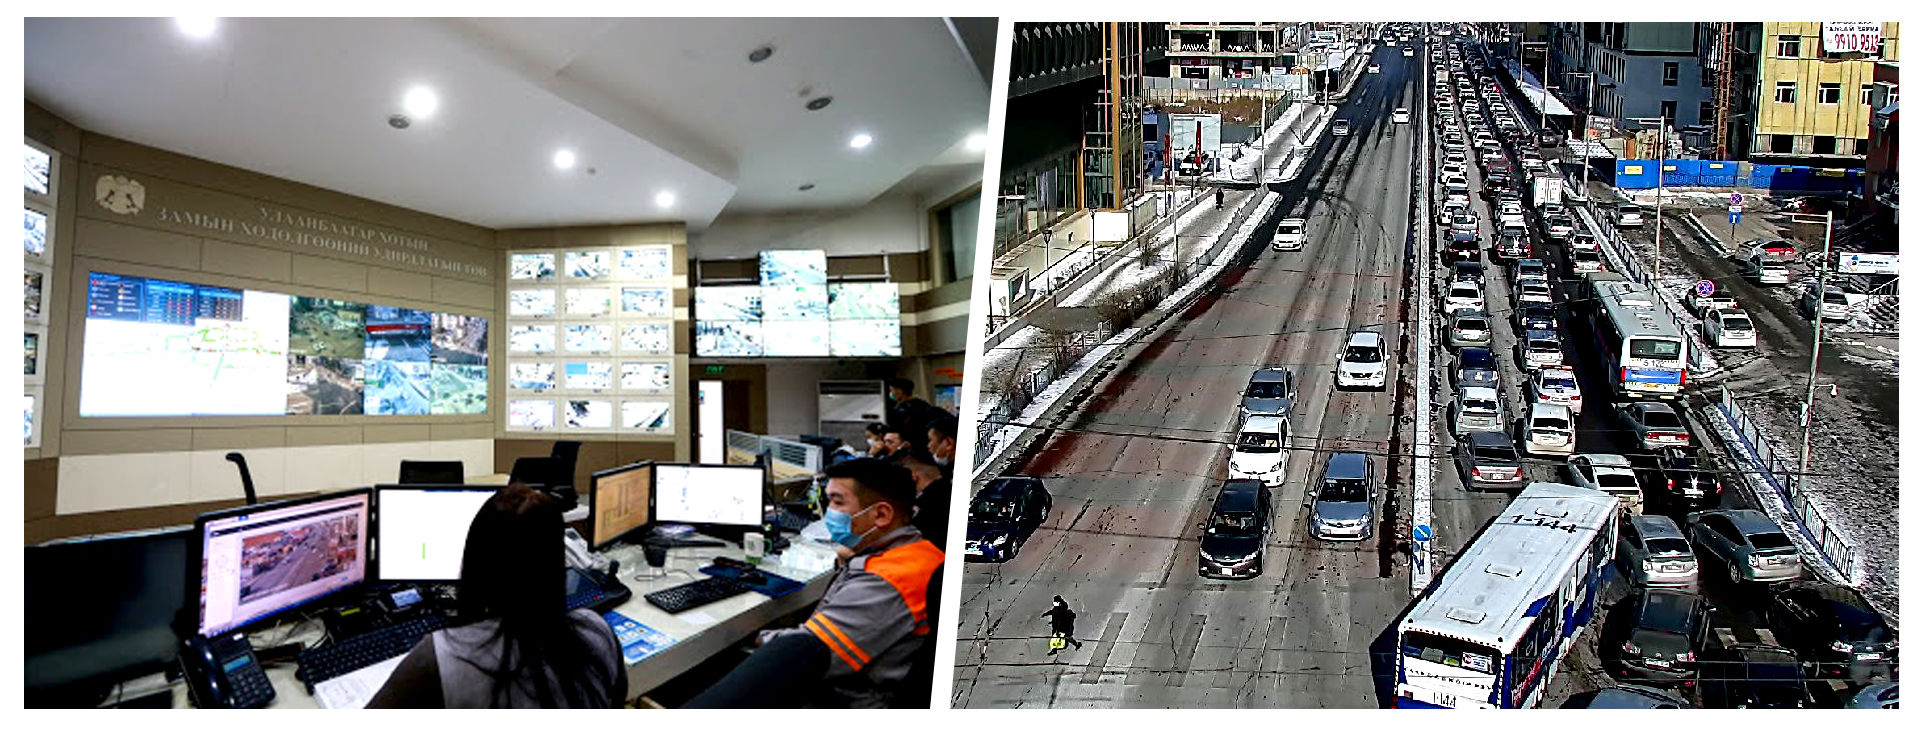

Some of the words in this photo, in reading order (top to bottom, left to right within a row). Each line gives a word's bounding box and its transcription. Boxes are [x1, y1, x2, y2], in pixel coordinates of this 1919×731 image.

[1834, 33, 1858, 50] 9910
[158, 207, 234, 233] ЗАМЫН
[259, 206, 376, 241] УЛААНБААТАР
[379, 231, 429, 252] ХОТЫН
[1512, 514, 1577, 534] 1-144
